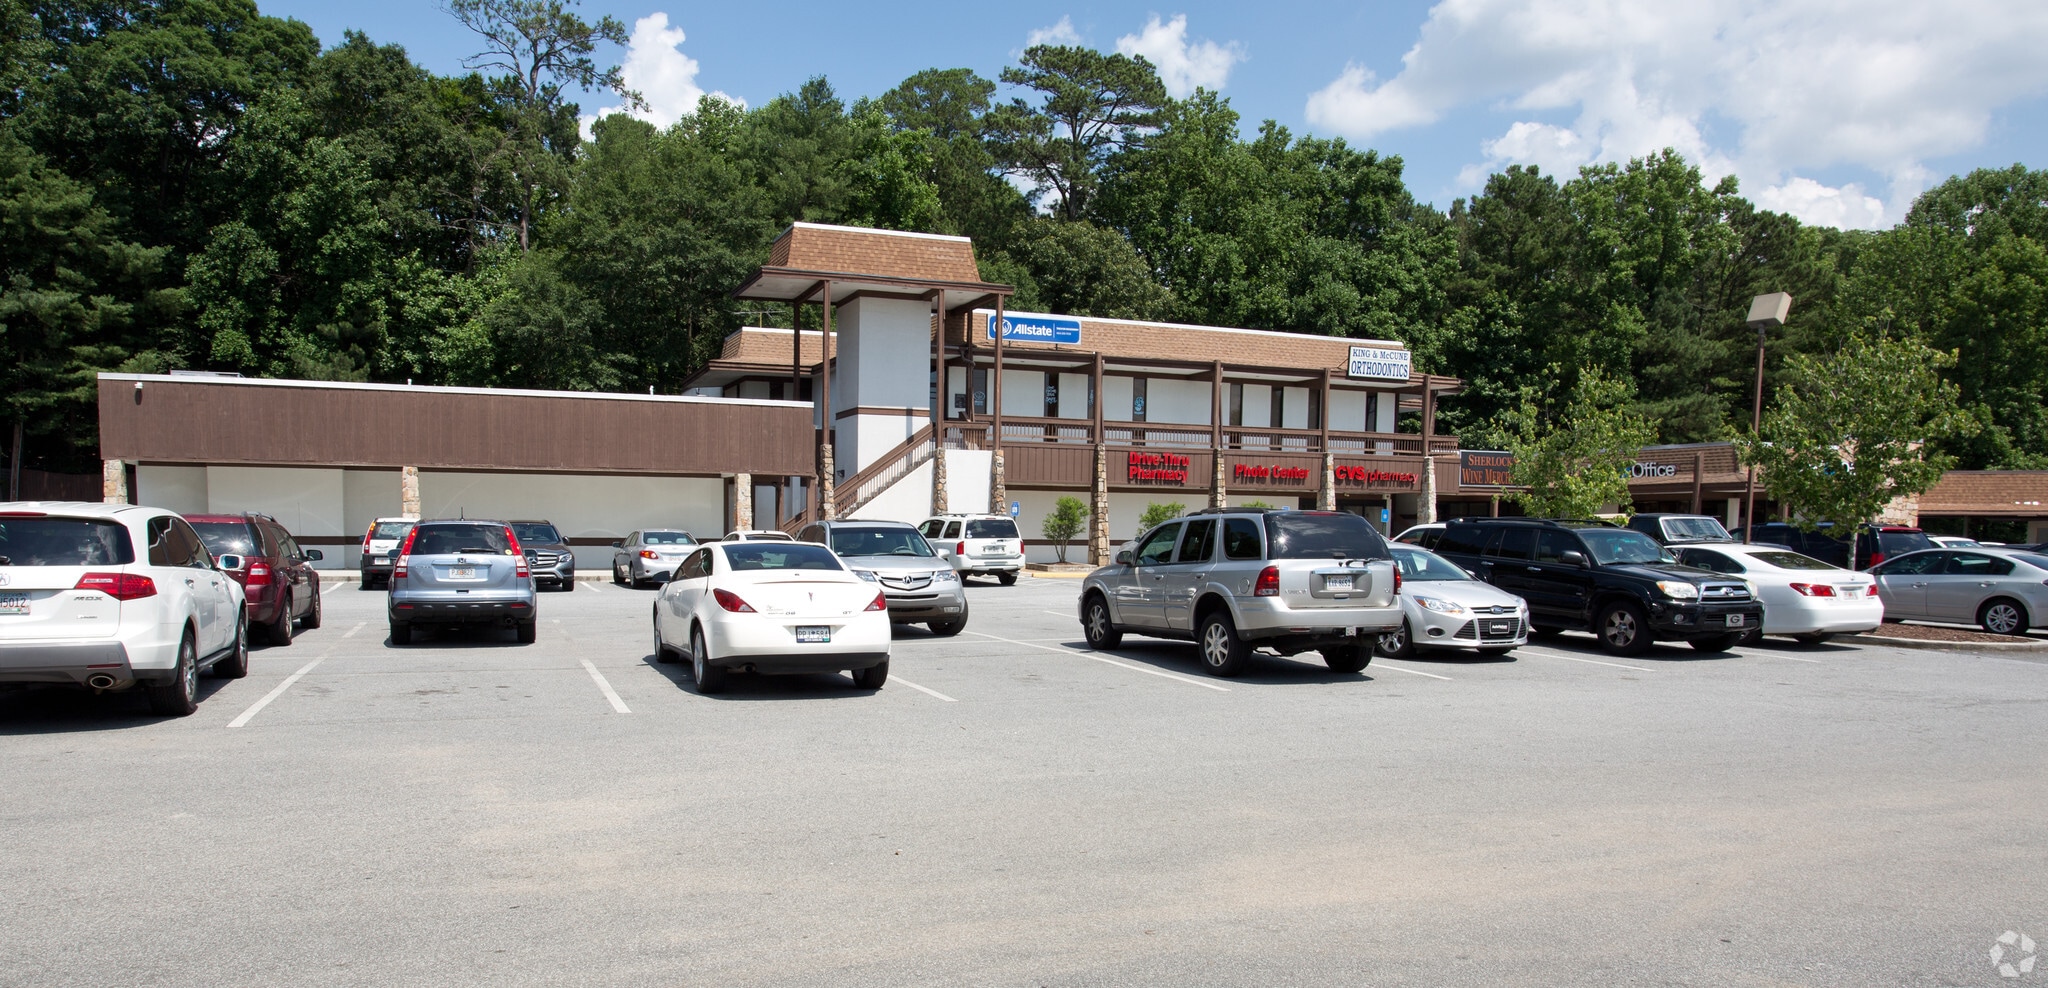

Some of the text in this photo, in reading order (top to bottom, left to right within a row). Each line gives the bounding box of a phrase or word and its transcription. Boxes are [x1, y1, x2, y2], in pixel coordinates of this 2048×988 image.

[1013, 324, 1052, 337] Allstate
[1352, 349, 1408, 361] KING & McCUNE
[1351, 360, 1408, 378] ORTHODONTICS
[1129, 451, 1190, 466] Drive-Thru
[1129, 465, 1188, 483] Pharmacy
[1235, 463, 1310, 479] Photo Center
[1462, 467, 1515, 485] WINE MERCH
[1632, 462, 1676, 478] Office
